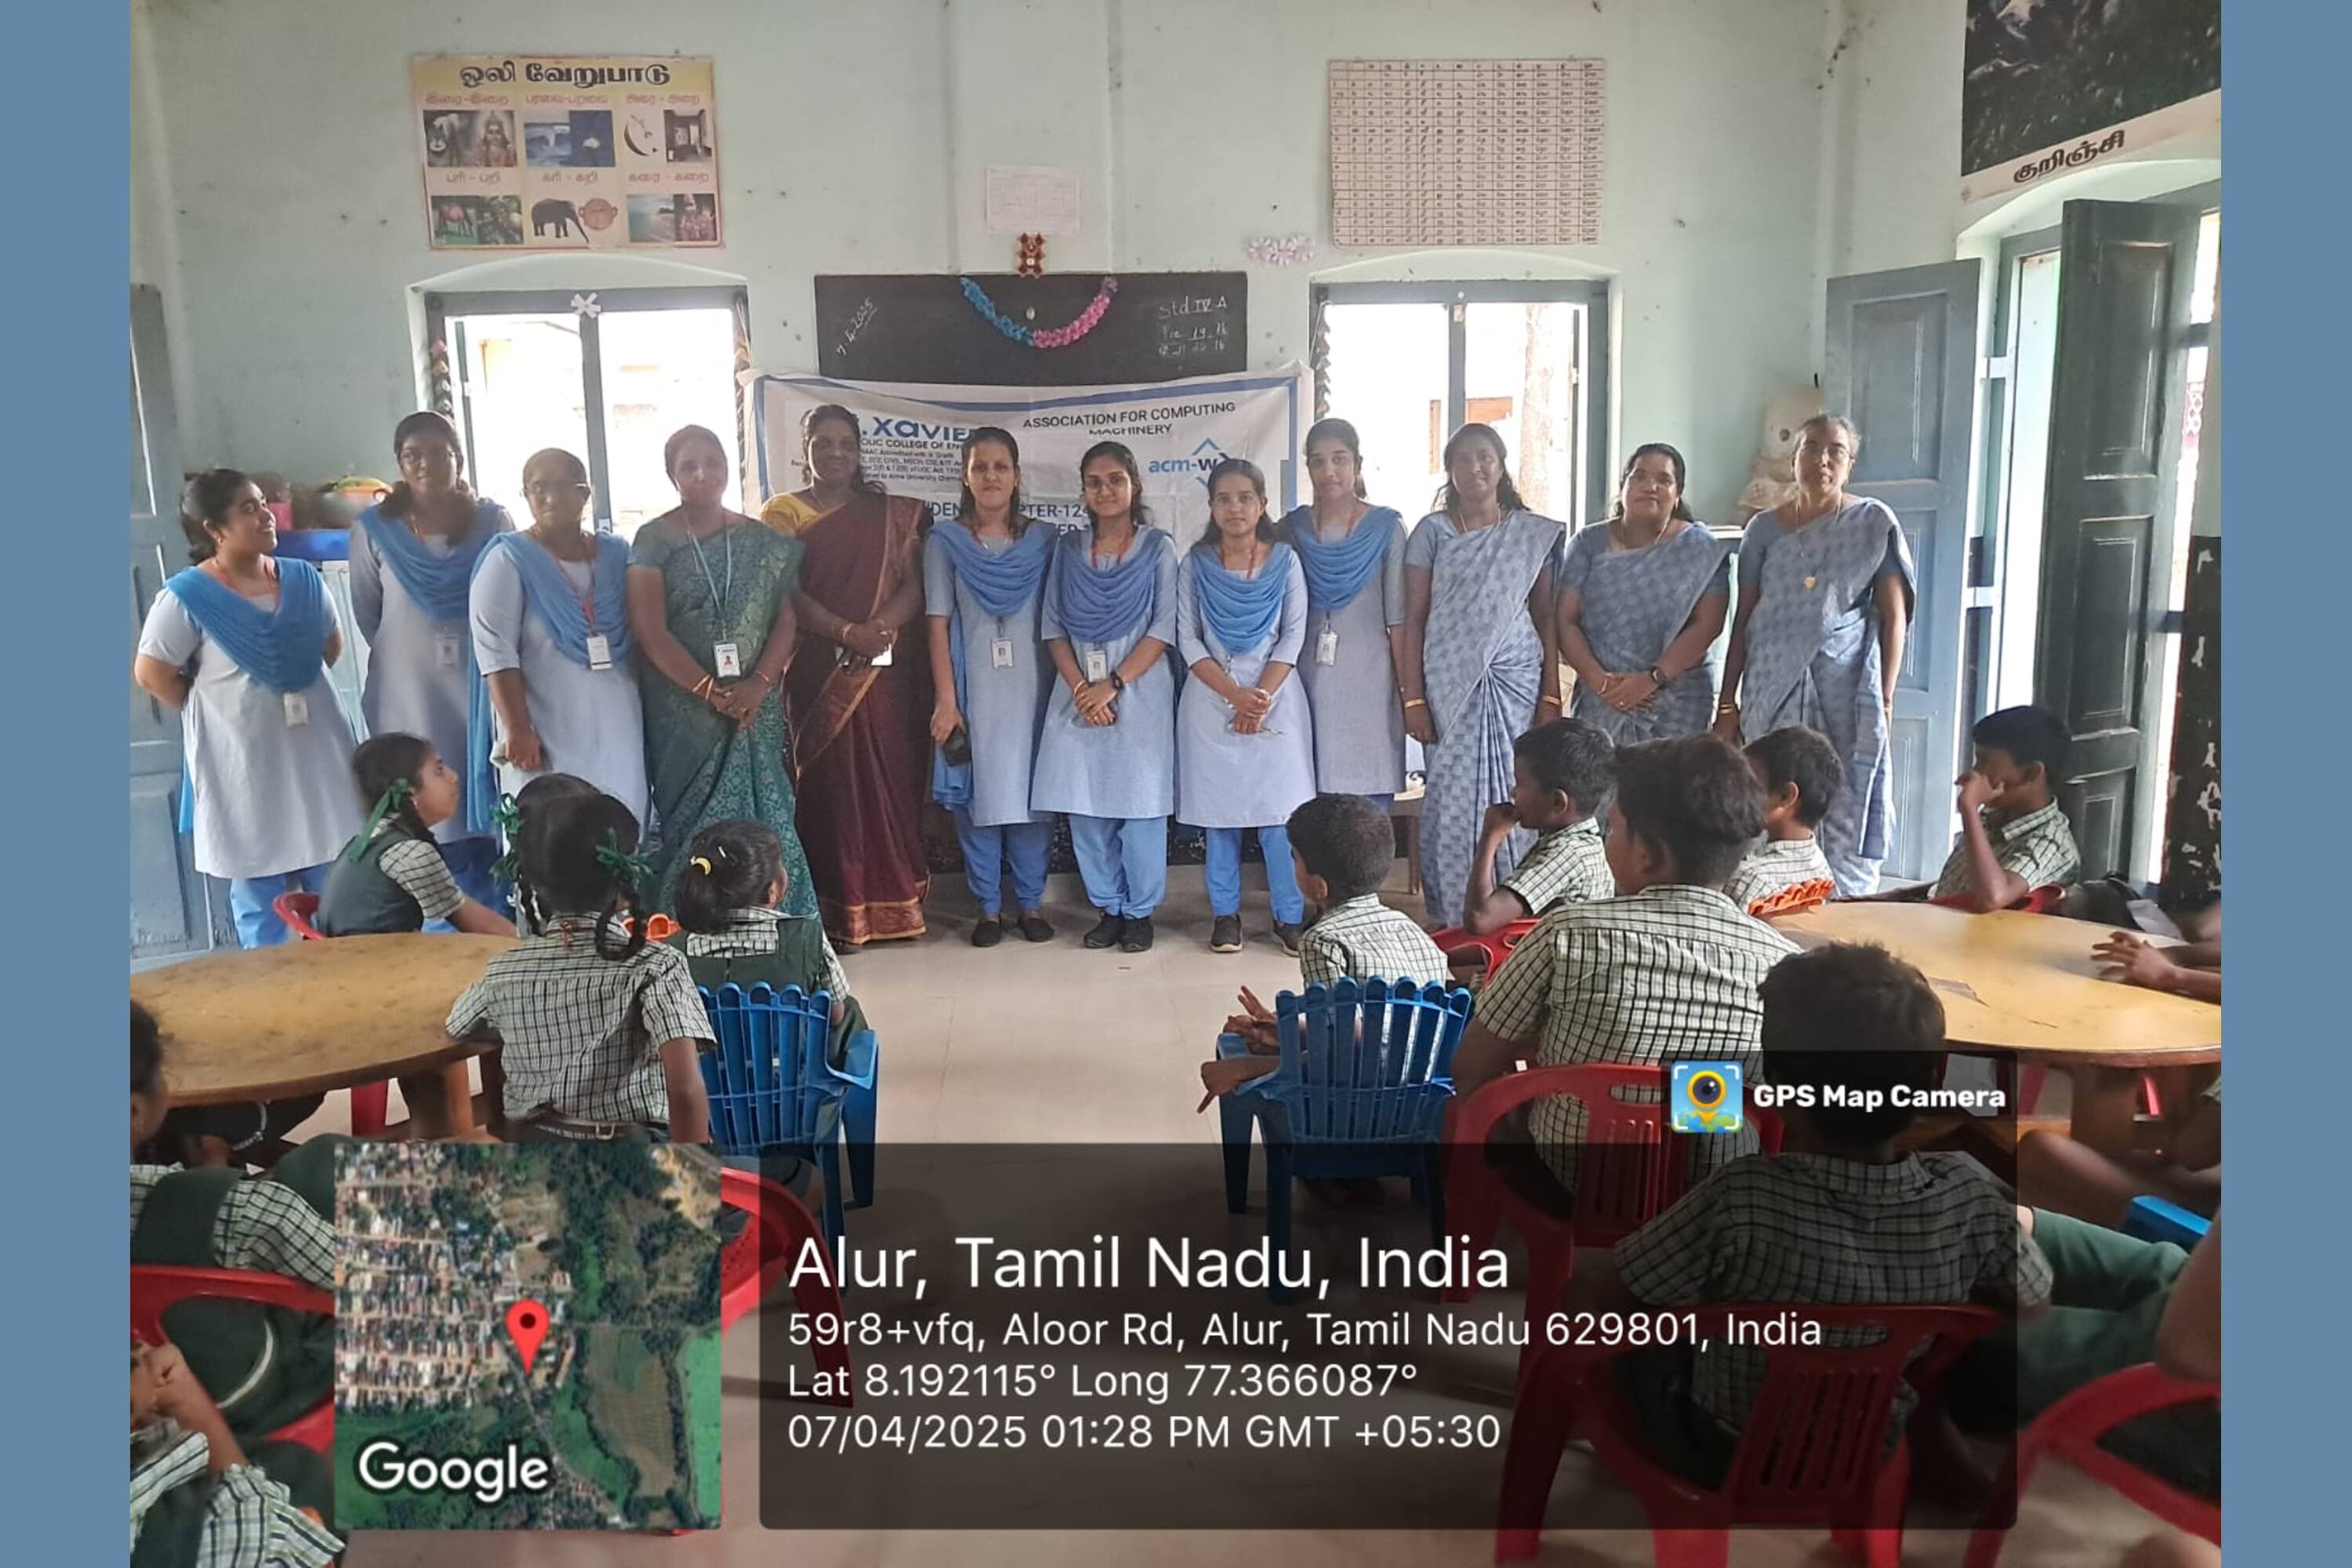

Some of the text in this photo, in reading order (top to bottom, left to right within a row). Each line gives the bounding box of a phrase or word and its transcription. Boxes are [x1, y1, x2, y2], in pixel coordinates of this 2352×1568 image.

[459, 61, 671, 89] ஒலி வேறுபாடு
[2013, 129, 2125, 183] குறிஞ்சி
[1159, 295, 1190, 319] Std
[1215, 296, 1227, 309] A
[1023, 401, 1236, 428] ASSOCIATION FOR COMPUTING
[1089, 423, 1173, 436] MACHINERY
[886, 440, 928, 448] COLLEGE
